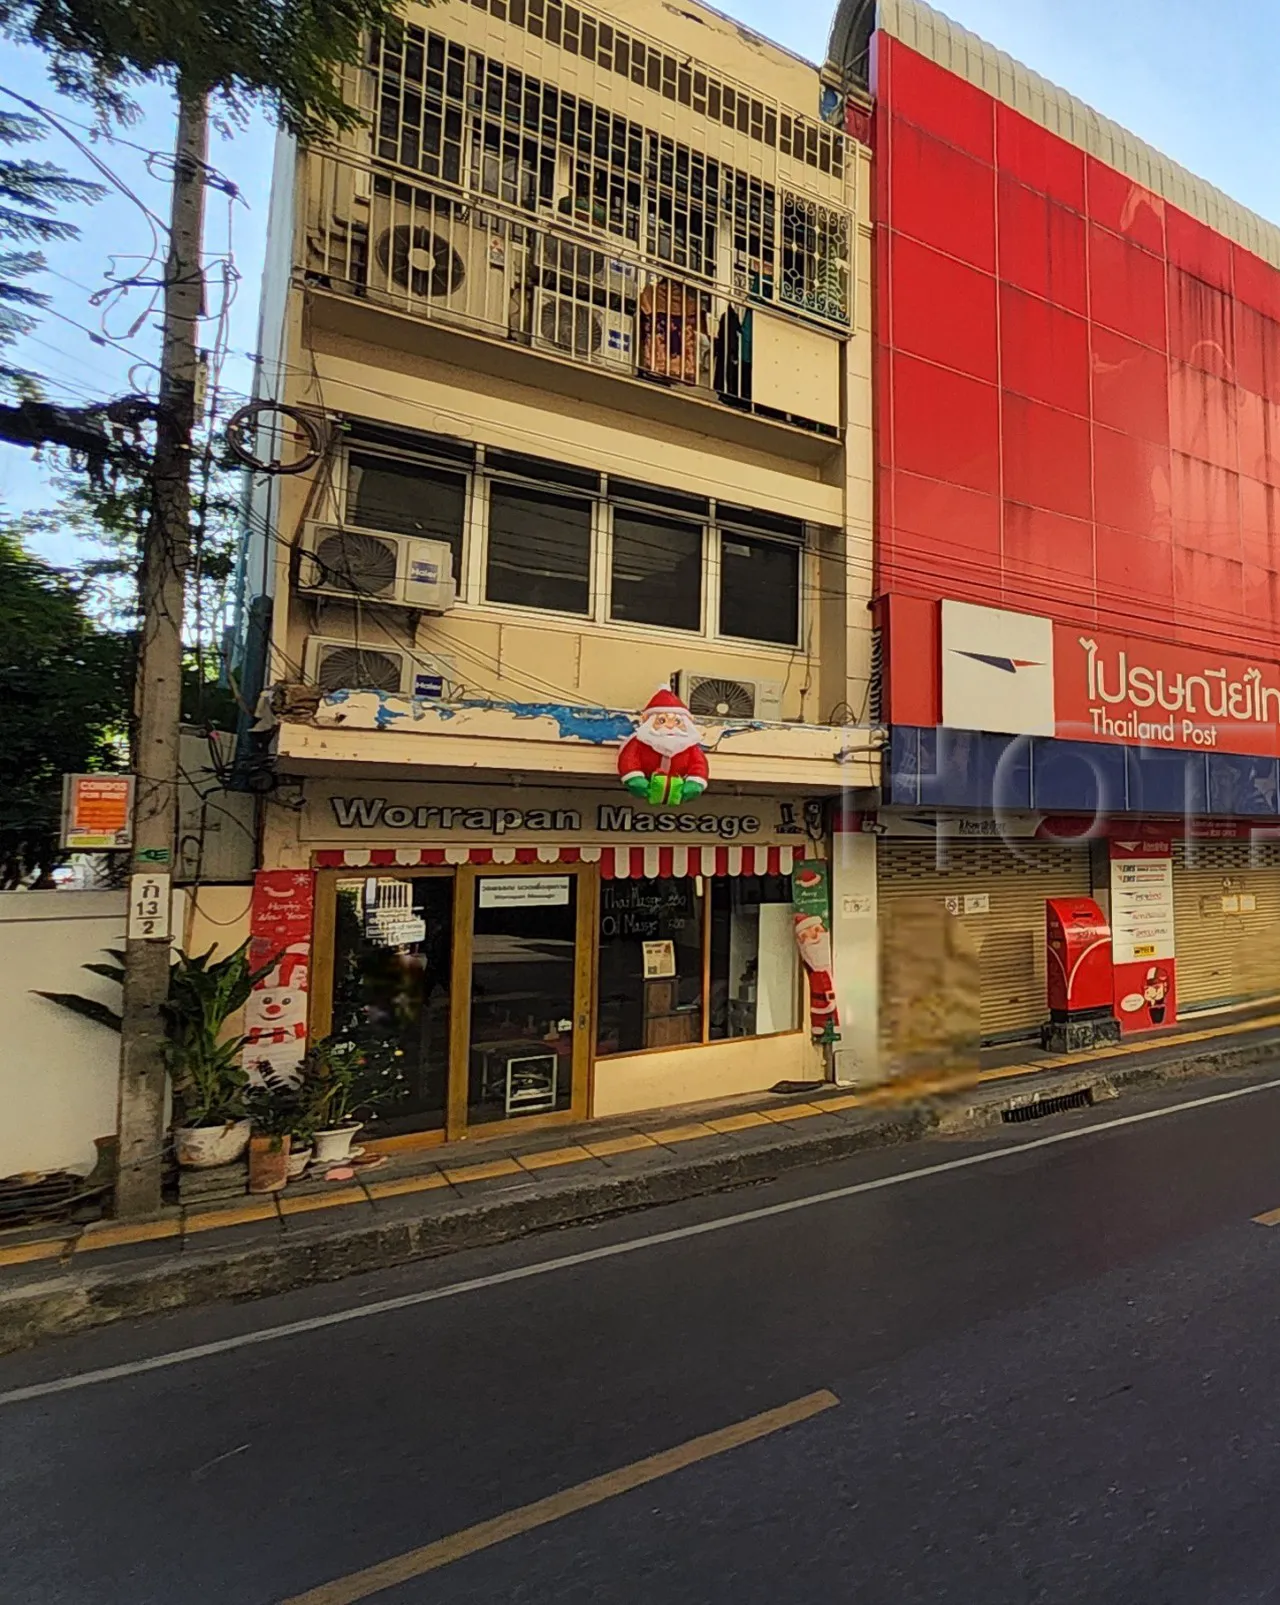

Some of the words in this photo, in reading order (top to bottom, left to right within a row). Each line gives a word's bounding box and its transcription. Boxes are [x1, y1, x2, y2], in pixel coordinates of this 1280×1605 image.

[411, 567, 437, 579] Haier
[415, 681, 442, 691] Haier
[1089, 706, 1174, 742] Thailand
[1182, 719, 1217, 746] Post
[331, 797, 582, 835] Worrapan
[597, 805, 760, 839] Massage
[136, 901, 158, 916] 13
[142, 920, 155, 934] 2
